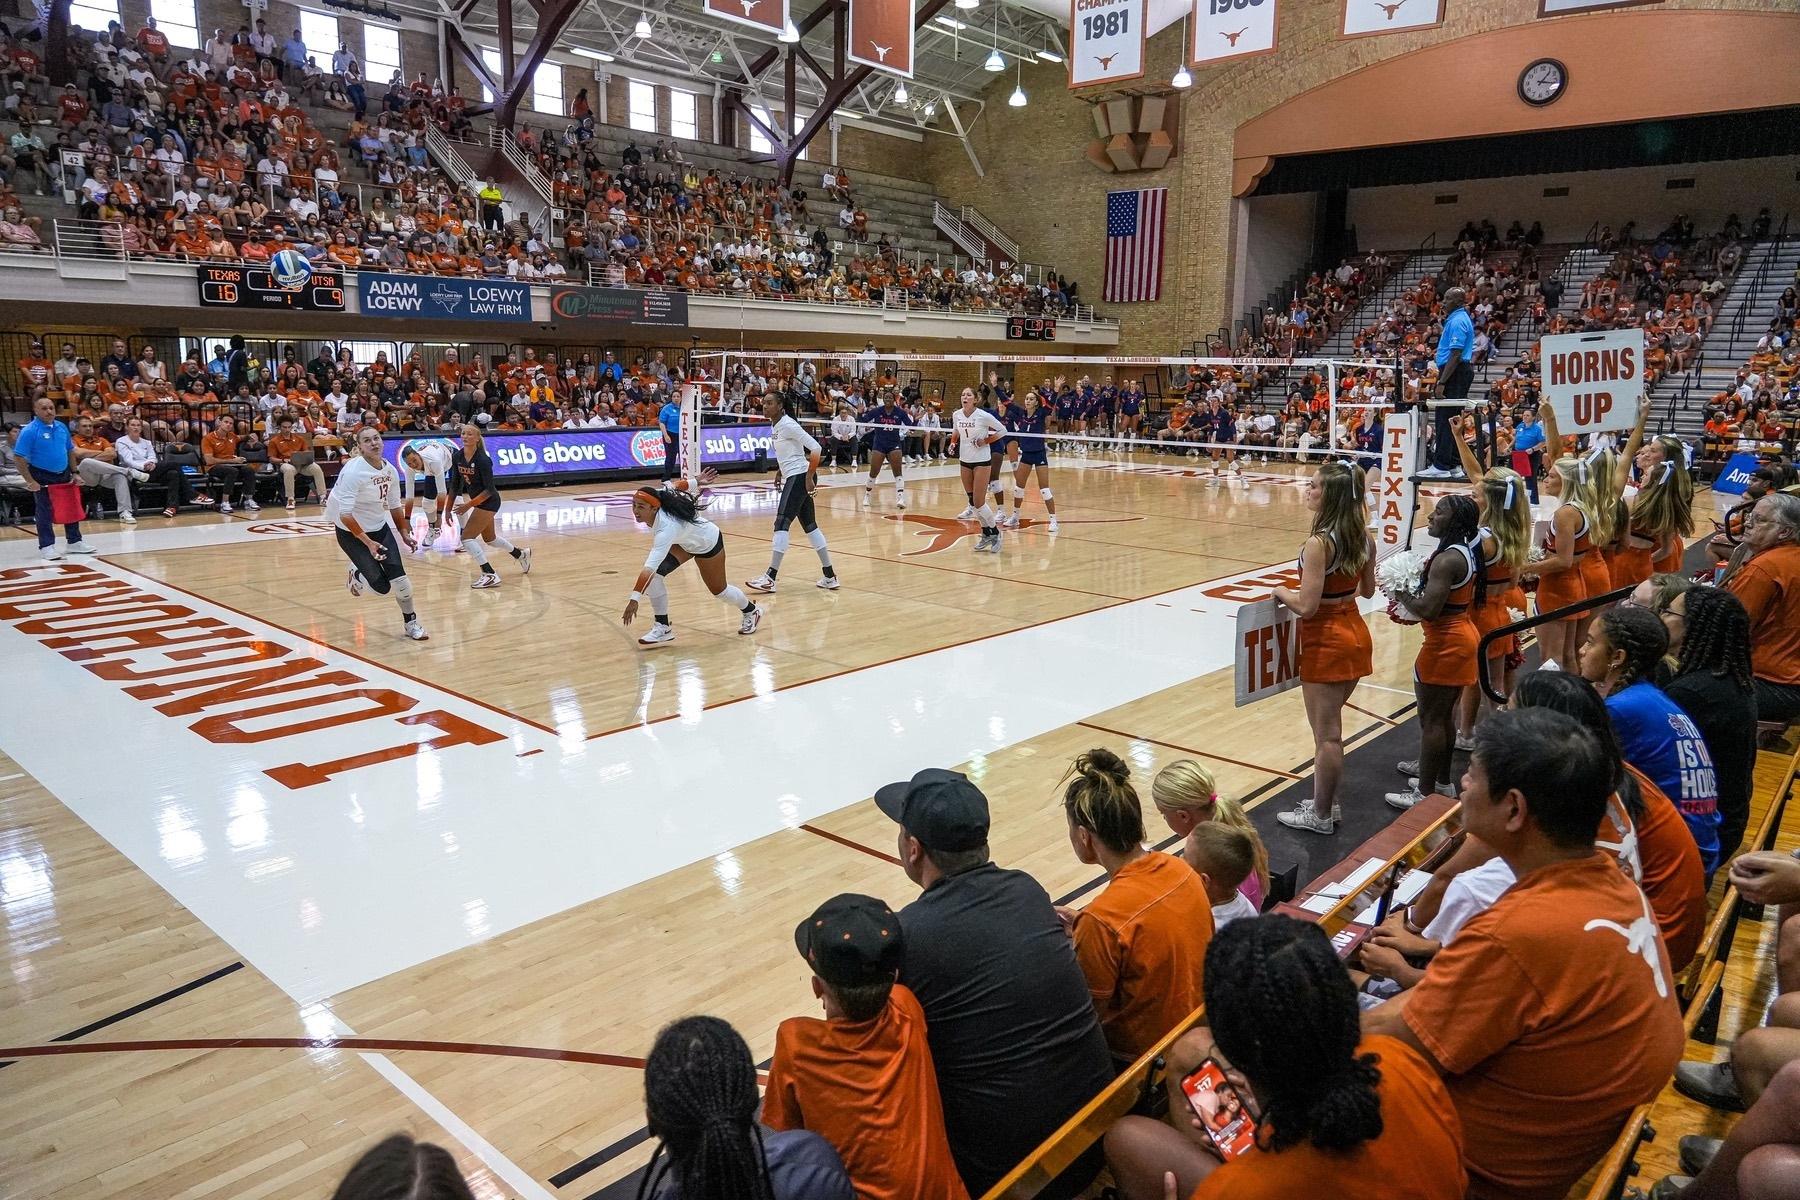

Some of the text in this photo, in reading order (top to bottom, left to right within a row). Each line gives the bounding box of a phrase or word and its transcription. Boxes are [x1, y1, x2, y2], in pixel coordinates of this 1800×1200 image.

[1083, 9, 1128, 40] 1981
[68, 156, 79, 165] 42
[208, 269, 241, 281] TEXAS
[311, 275, 335, 287] UTSA
[218, 285, 235, 301] 16
[369, 281, 418, 297] ADAM
[469, 286, 524, 303] LOEWY
[287, 295, 292, 305] 1
[332, 290, 342, 305] 9
[367, 296, 423, 311] LOEWY
[470, 303, 522, 315] LAW FIRM
[1551, 347, 1635, 386] HORNS
[1573, 392, 1612, 426] UP
[964, 428, 969, 438] 1
[705, 434, 736, 454] sub
[497, 441, 606, 466] sub above
[1725, 468, 1752, 484] Am
[379, 484, 389, 499] 13
[1381, 428, 1407, 544] TEXAS
[1676, 739, 1699, 769] IS
